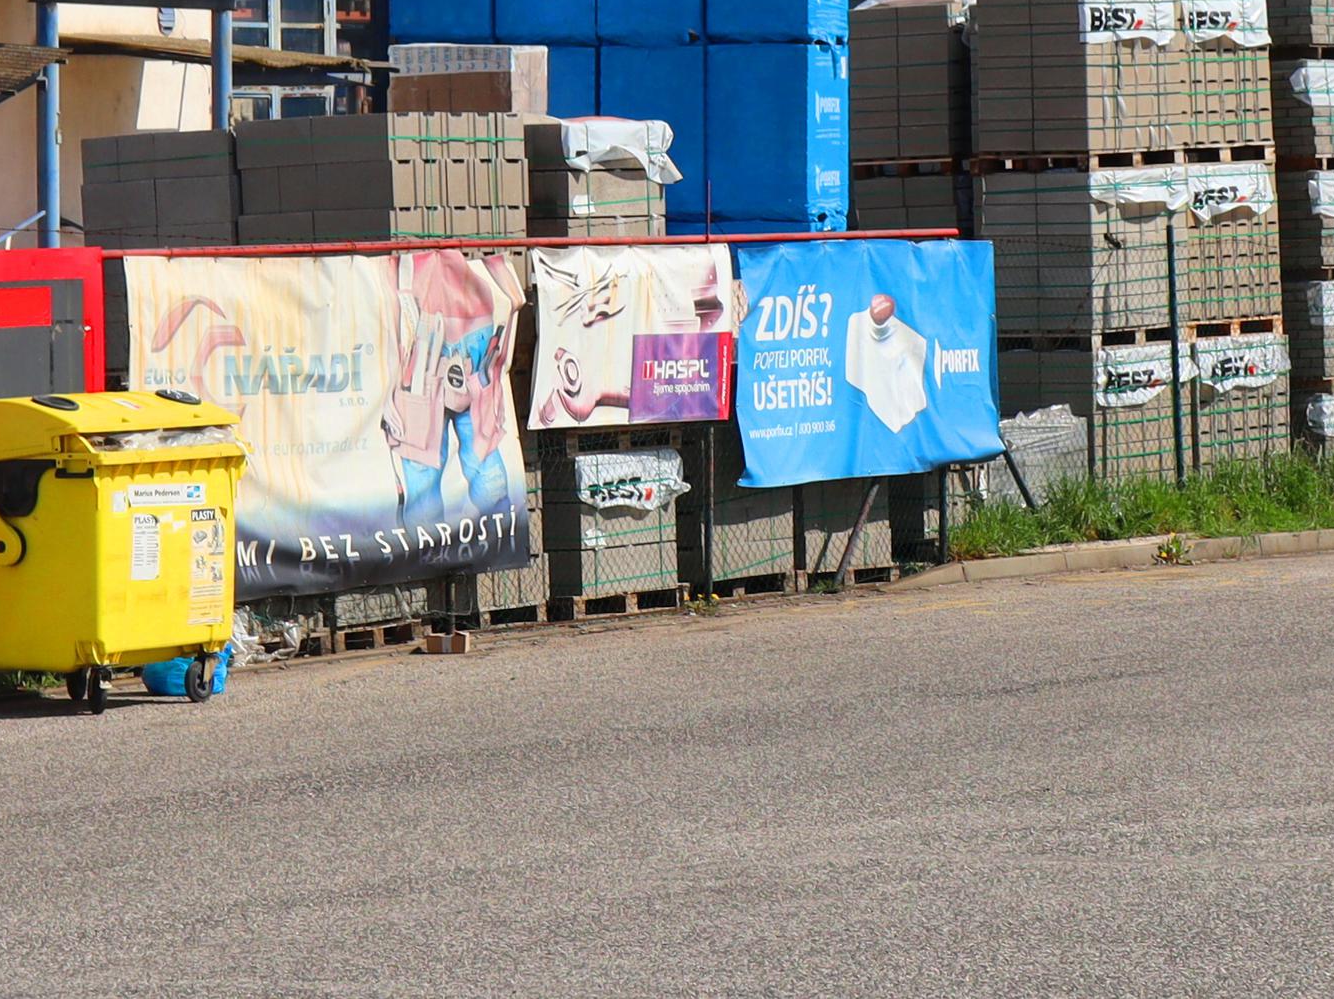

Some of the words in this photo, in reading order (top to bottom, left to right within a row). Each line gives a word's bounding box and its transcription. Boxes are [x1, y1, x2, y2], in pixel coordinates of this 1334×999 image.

[1090, 6, 1136, 31] BEST
[755, 284, 833, 342] ZDÍŠ?
[223, 343, 364, 396] NÁŘADÍ
[753, 350, 789, 370] POPTEJ
[942, 348, 980, 373] PORFIX
[144, 367, 187, 385] EURO
[753, 370, 833, 411] UŠETŘÍŠ!
[191, 510, 215, 521] PLASTY
[299, 533, 361, 562] BEZ
[374, 504, 517, 554] STAROSTÍ
